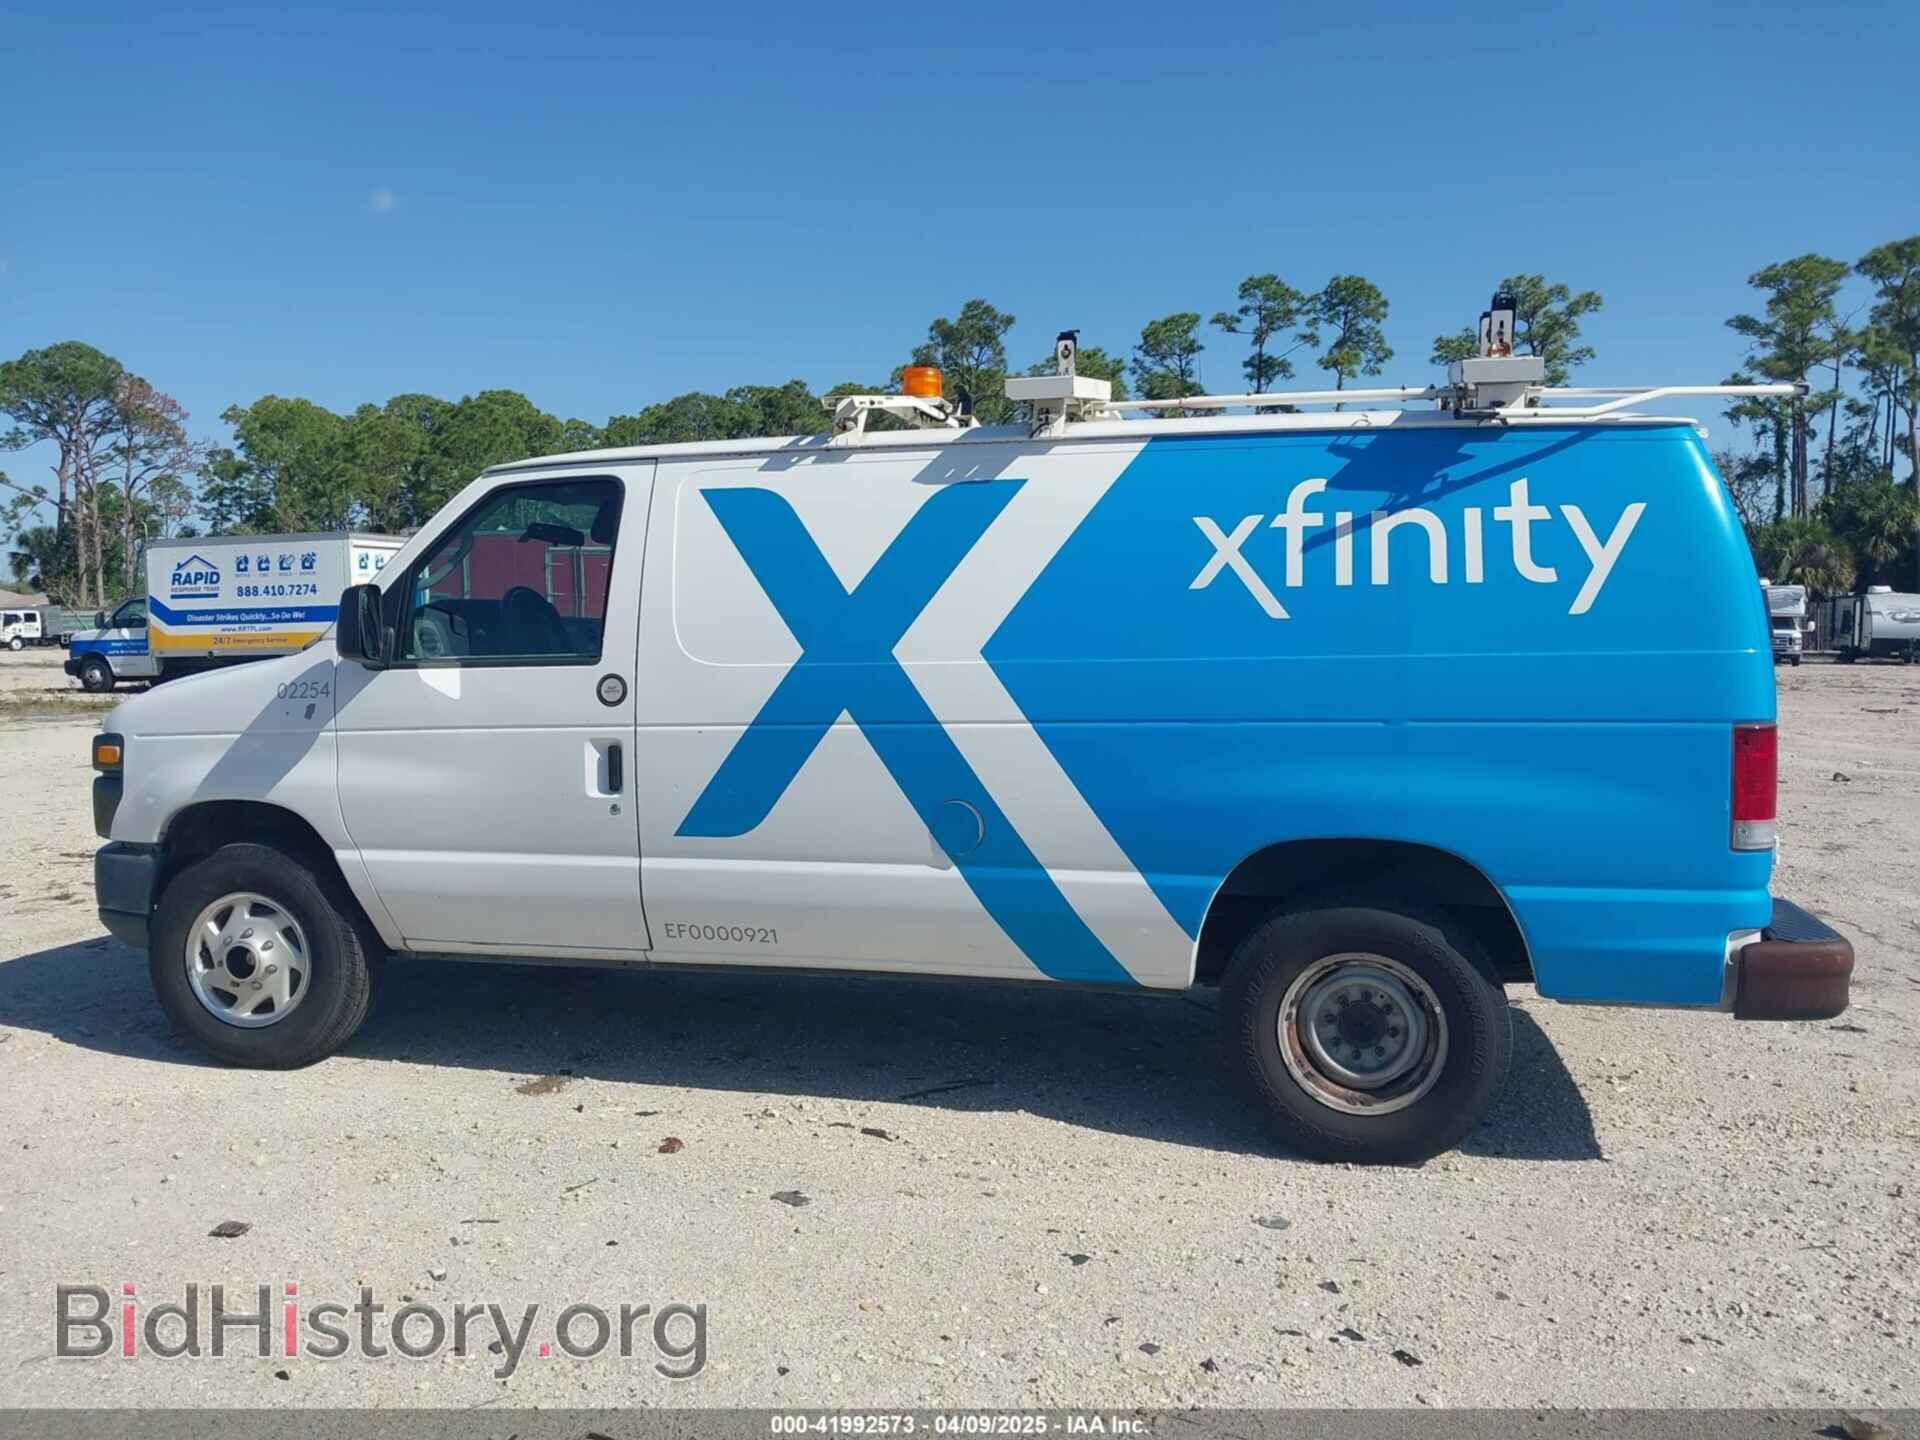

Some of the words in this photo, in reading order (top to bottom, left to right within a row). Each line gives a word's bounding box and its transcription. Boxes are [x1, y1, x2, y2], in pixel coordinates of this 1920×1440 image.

[1188, 477, 1647, 619] xfinity
[171, 571, 221, 585] RAPID
[236, 584, 318, 598] 888.410.7274
[213, 636, 231, 645] 24/7
[277, 682, 331, 700] 02254
[664, 922, 778, 944] EF0000921
